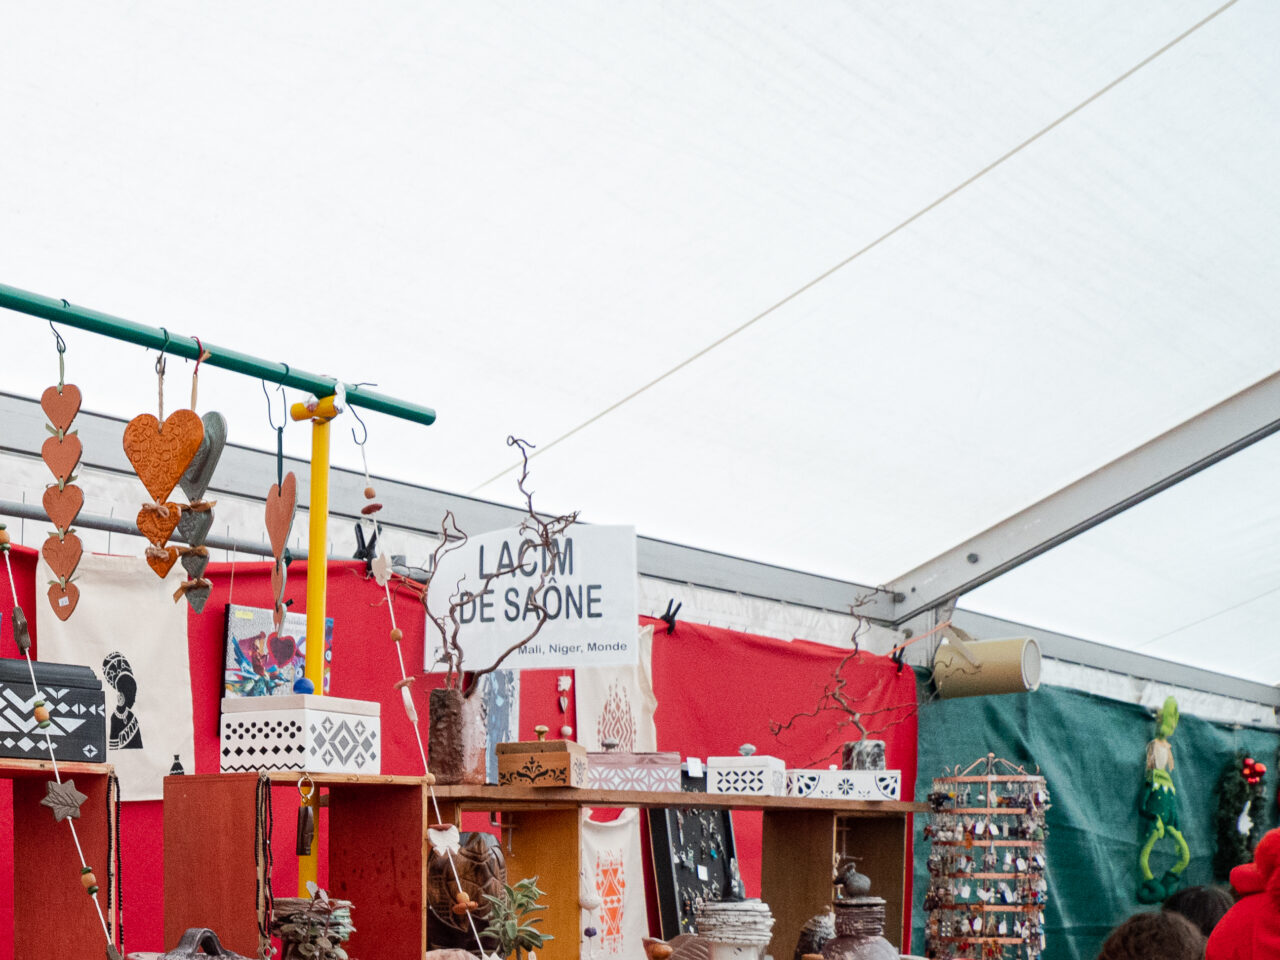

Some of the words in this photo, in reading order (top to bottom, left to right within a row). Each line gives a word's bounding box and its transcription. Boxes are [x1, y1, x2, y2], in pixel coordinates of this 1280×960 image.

[478, 537, 574, 580] LACIM
[459, 588, 495, 624] DE
[504, 577, 603, 622] SAÔNE
[517, 644, 545, 656] Mali,
[548, 642, 584, 655] Niger,
[587, 641, 628, 653] Monde
